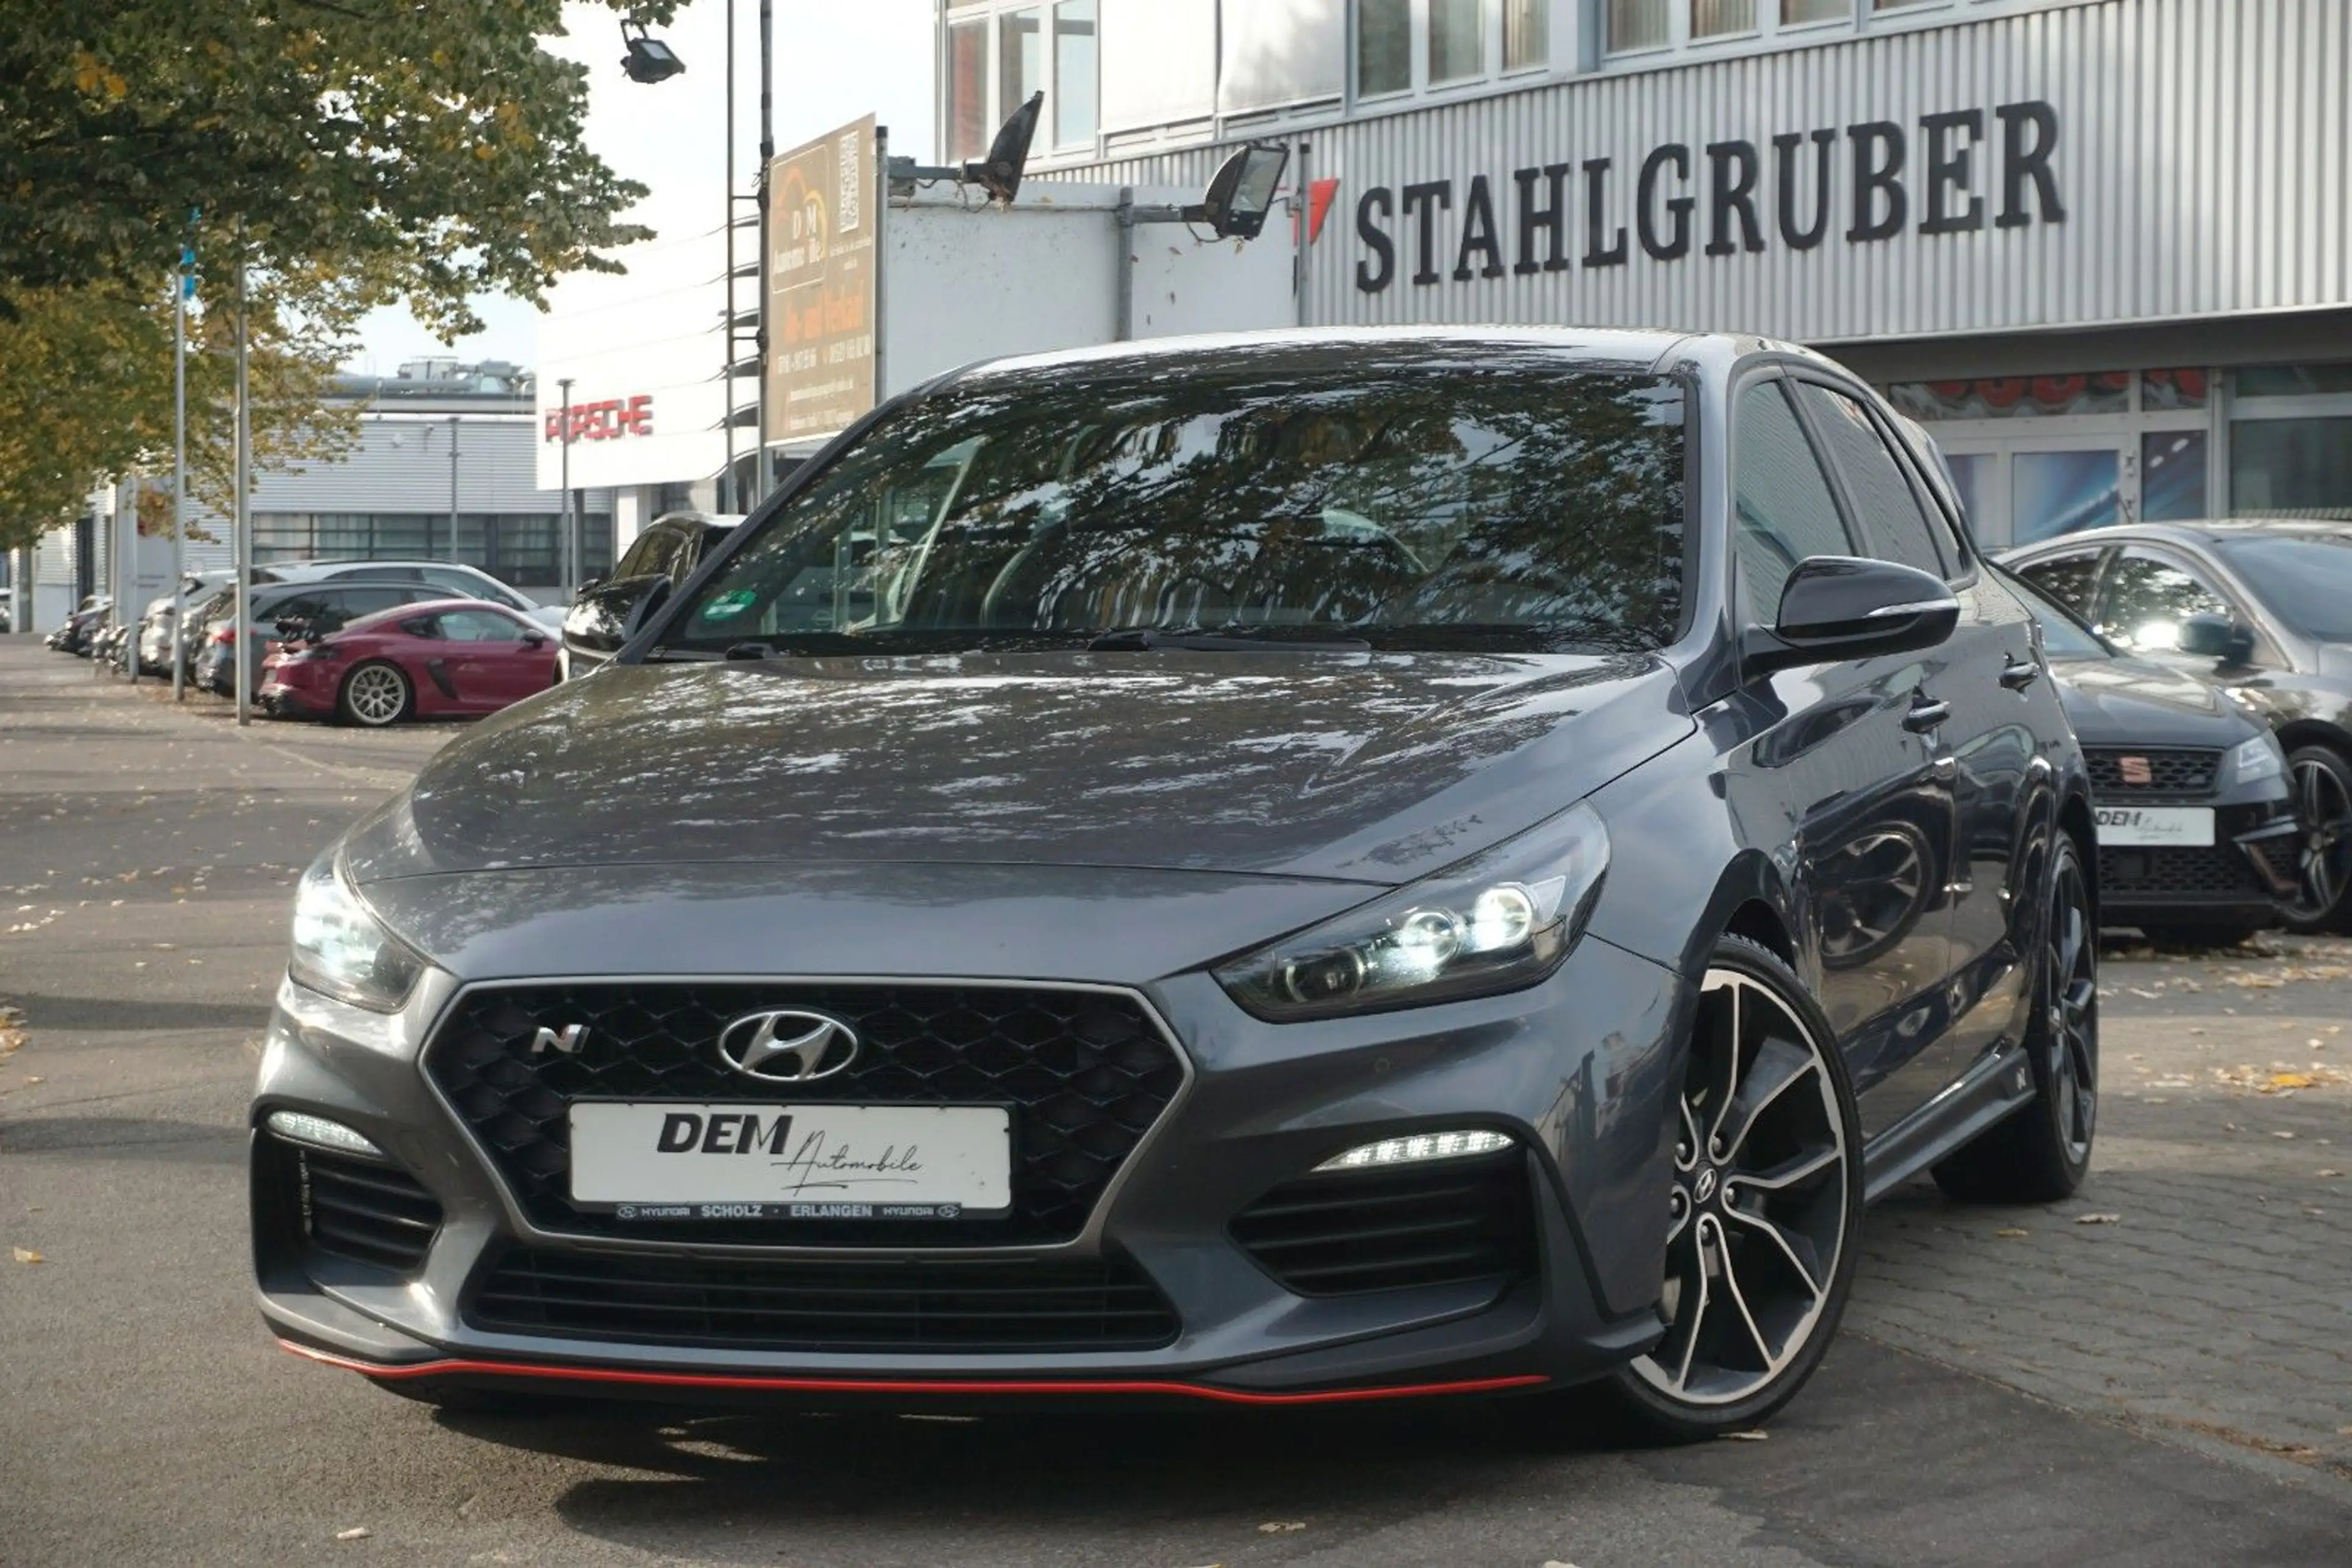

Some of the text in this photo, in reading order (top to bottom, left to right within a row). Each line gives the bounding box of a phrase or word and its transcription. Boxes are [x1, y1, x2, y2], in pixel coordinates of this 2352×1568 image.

[1355, 99, 2067, 293] STAHLGRUBER
[2095, 810, 2143, 826] DEM
[657, 1113, 794, 1155] DEM
[771, 1130, 922, 1197] Automobile
[641, 1205, 935, 1218] HYUNDAI SCHOLZ ERLANGEN HYUNDAI
